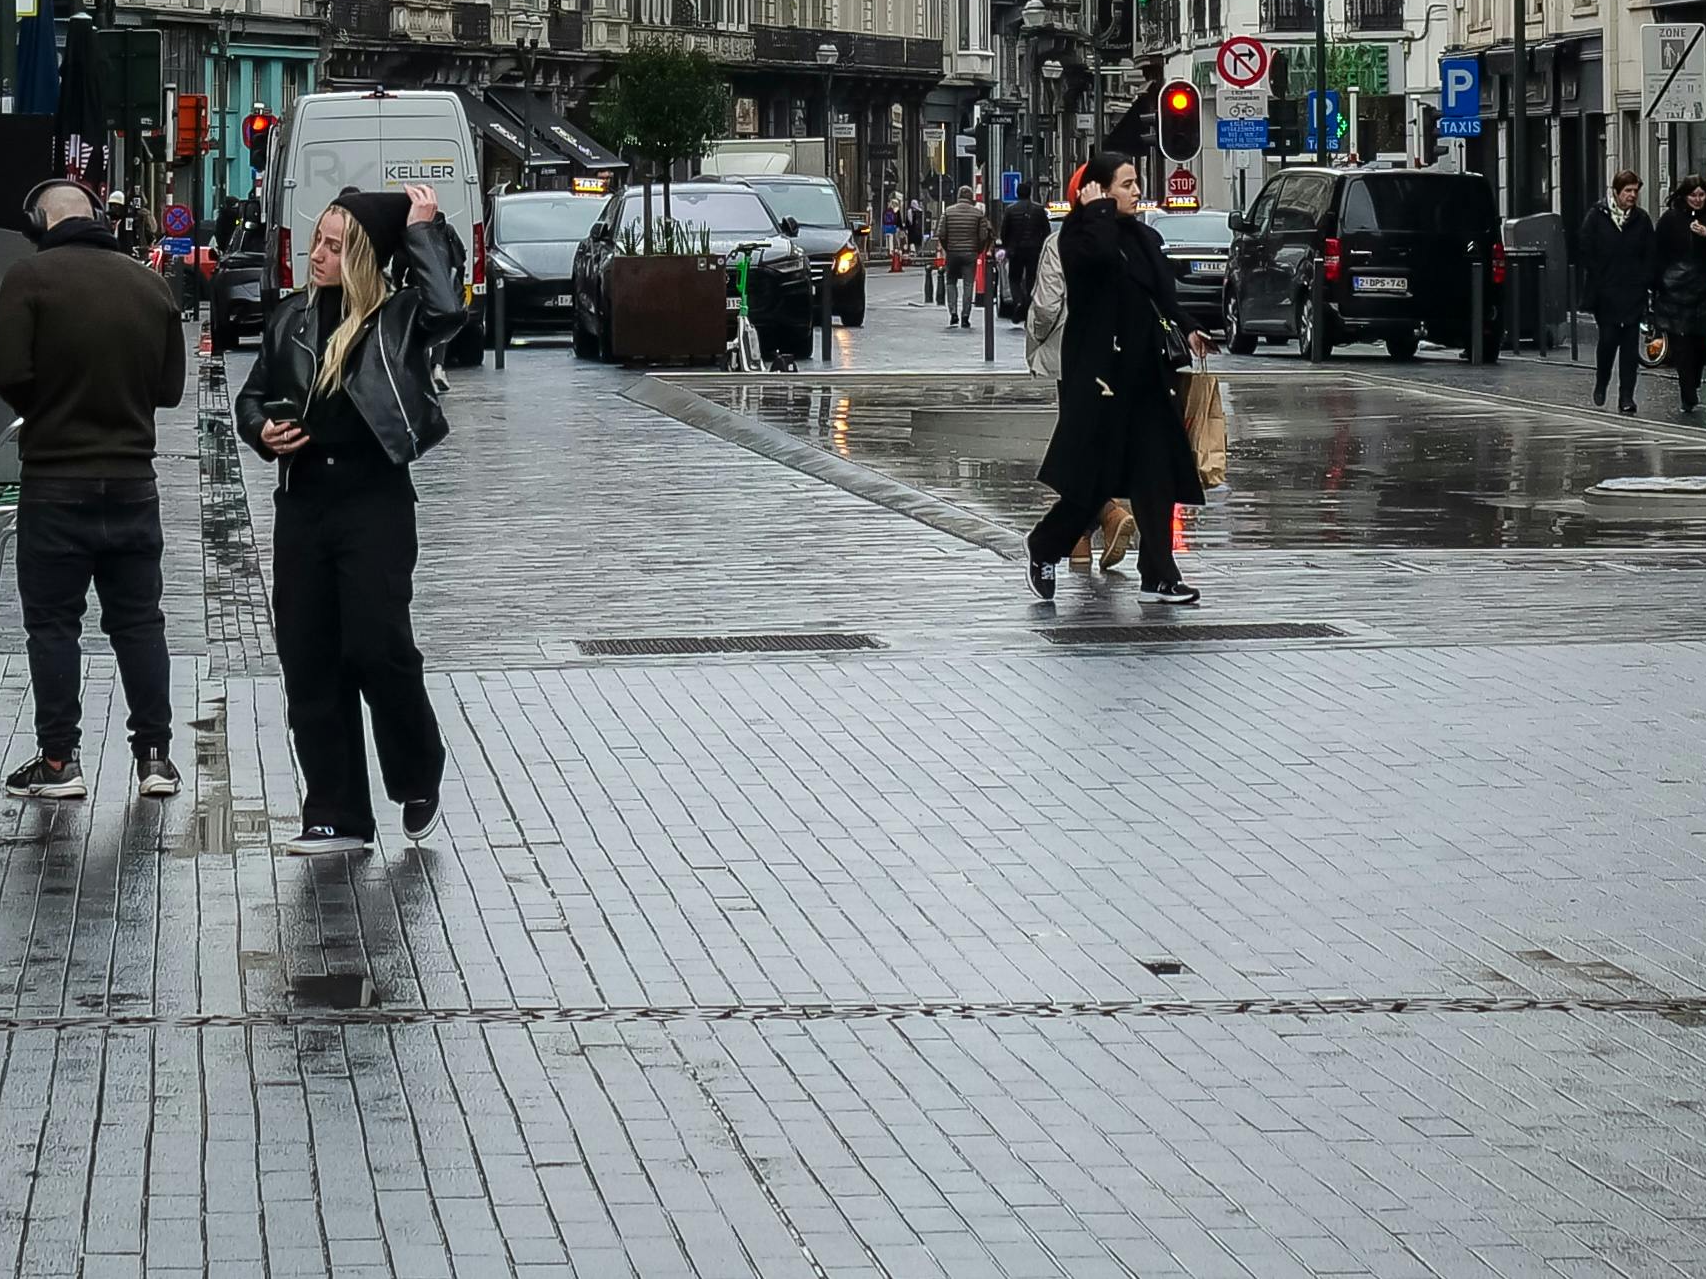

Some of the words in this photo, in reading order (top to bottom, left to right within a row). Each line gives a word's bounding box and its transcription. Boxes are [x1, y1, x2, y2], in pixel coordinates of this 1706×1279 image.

[1659, 28, 1686, 38] ZONE
[1447, 69, 1474, 108] P
[1444, 121, 1481, 134] TAXIS
[385, 165, 454, 179] KELLER
[1170, 178, 1196, 190] STOP
